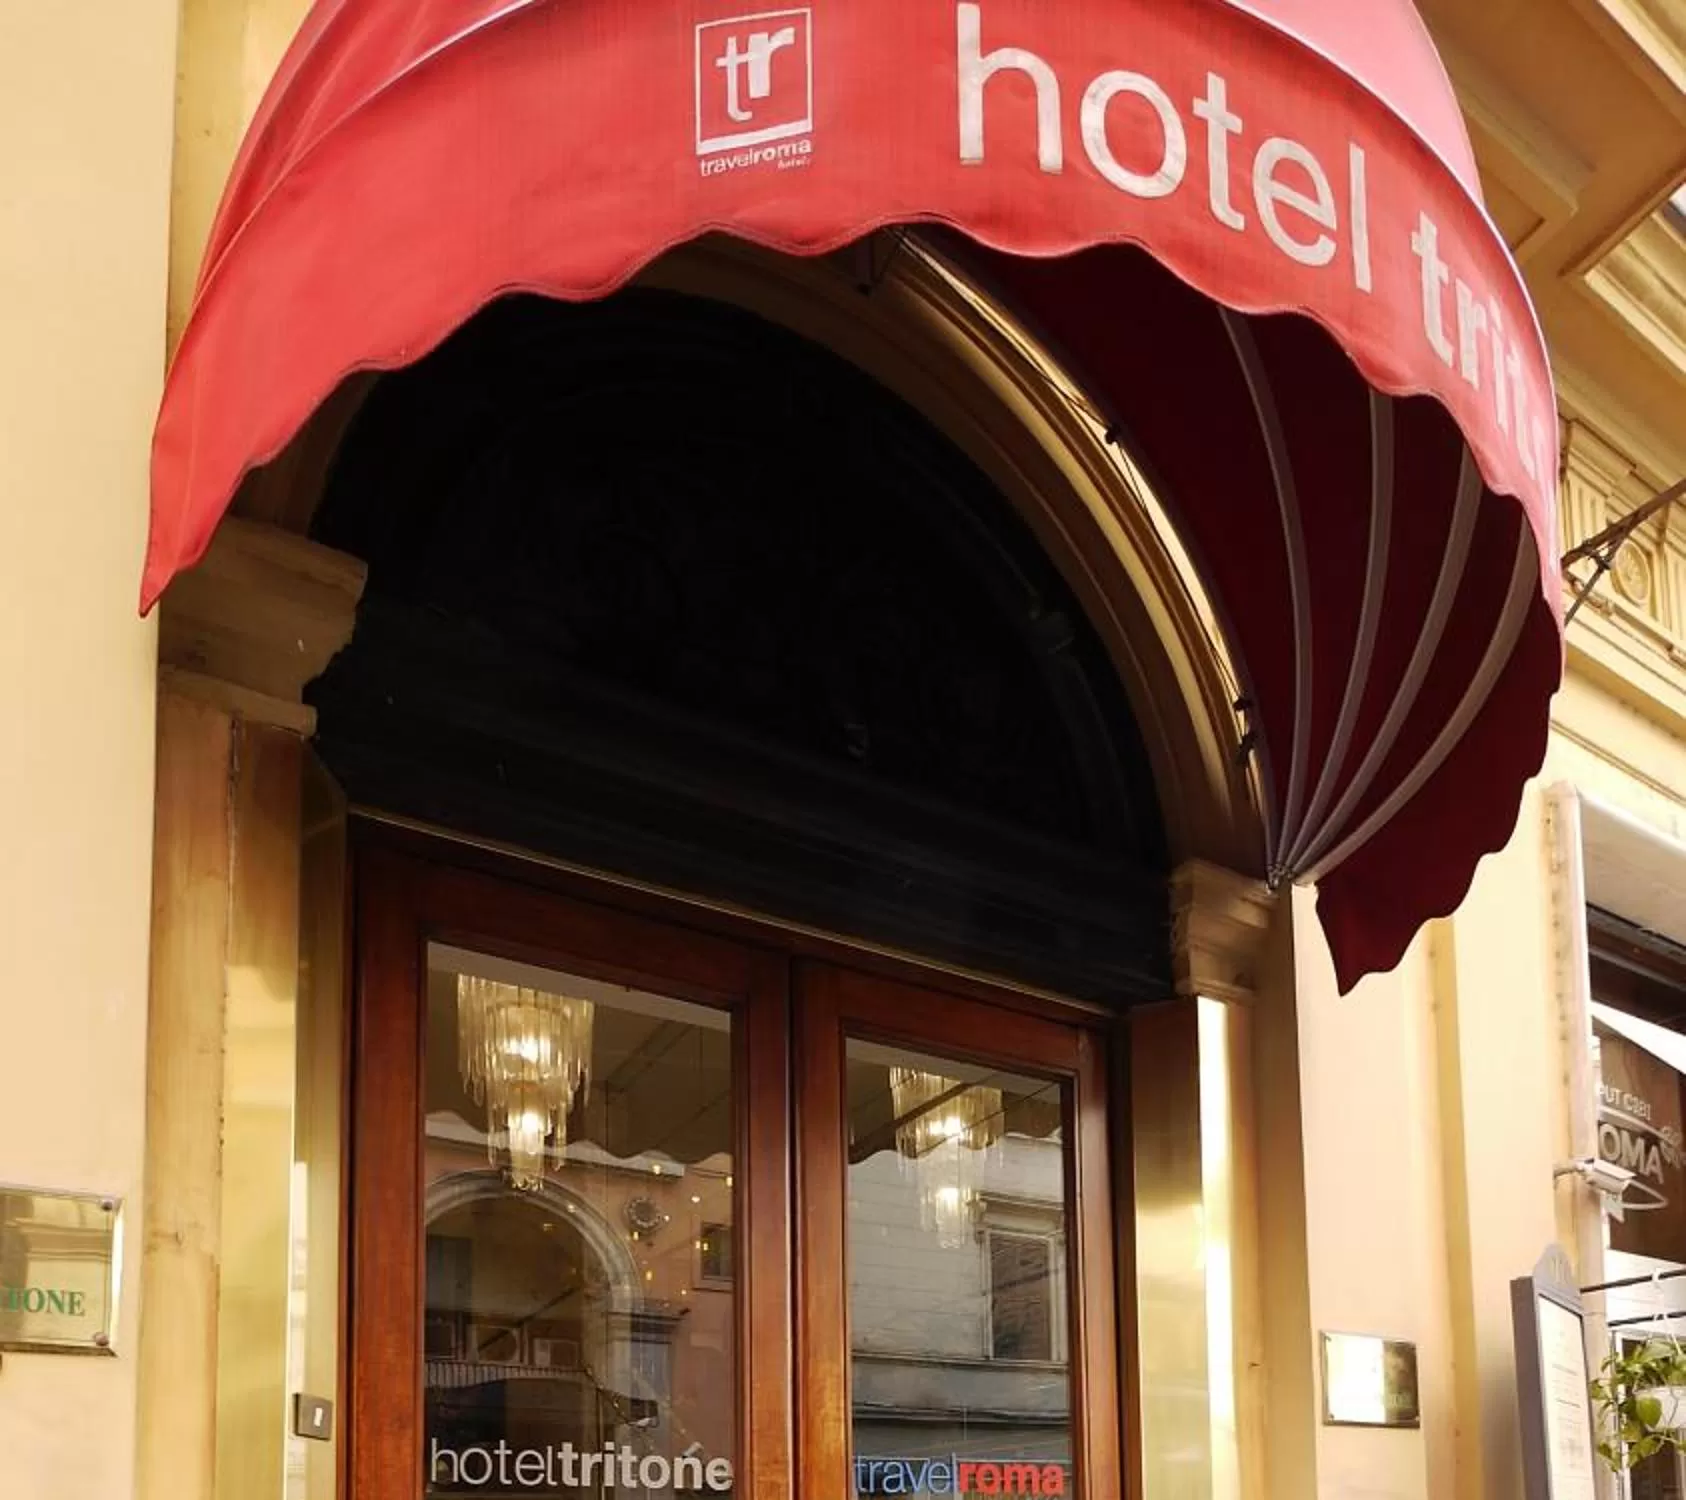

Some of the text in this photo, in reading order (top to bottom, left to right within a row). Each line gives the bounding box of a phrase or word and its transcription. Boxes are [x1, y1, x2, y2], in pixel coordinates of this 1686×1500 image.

[715, 27, 795, 122] tr
[957, 2, 1371, 294] hotel
[1599, 1123, 1664, 1185] OMA
